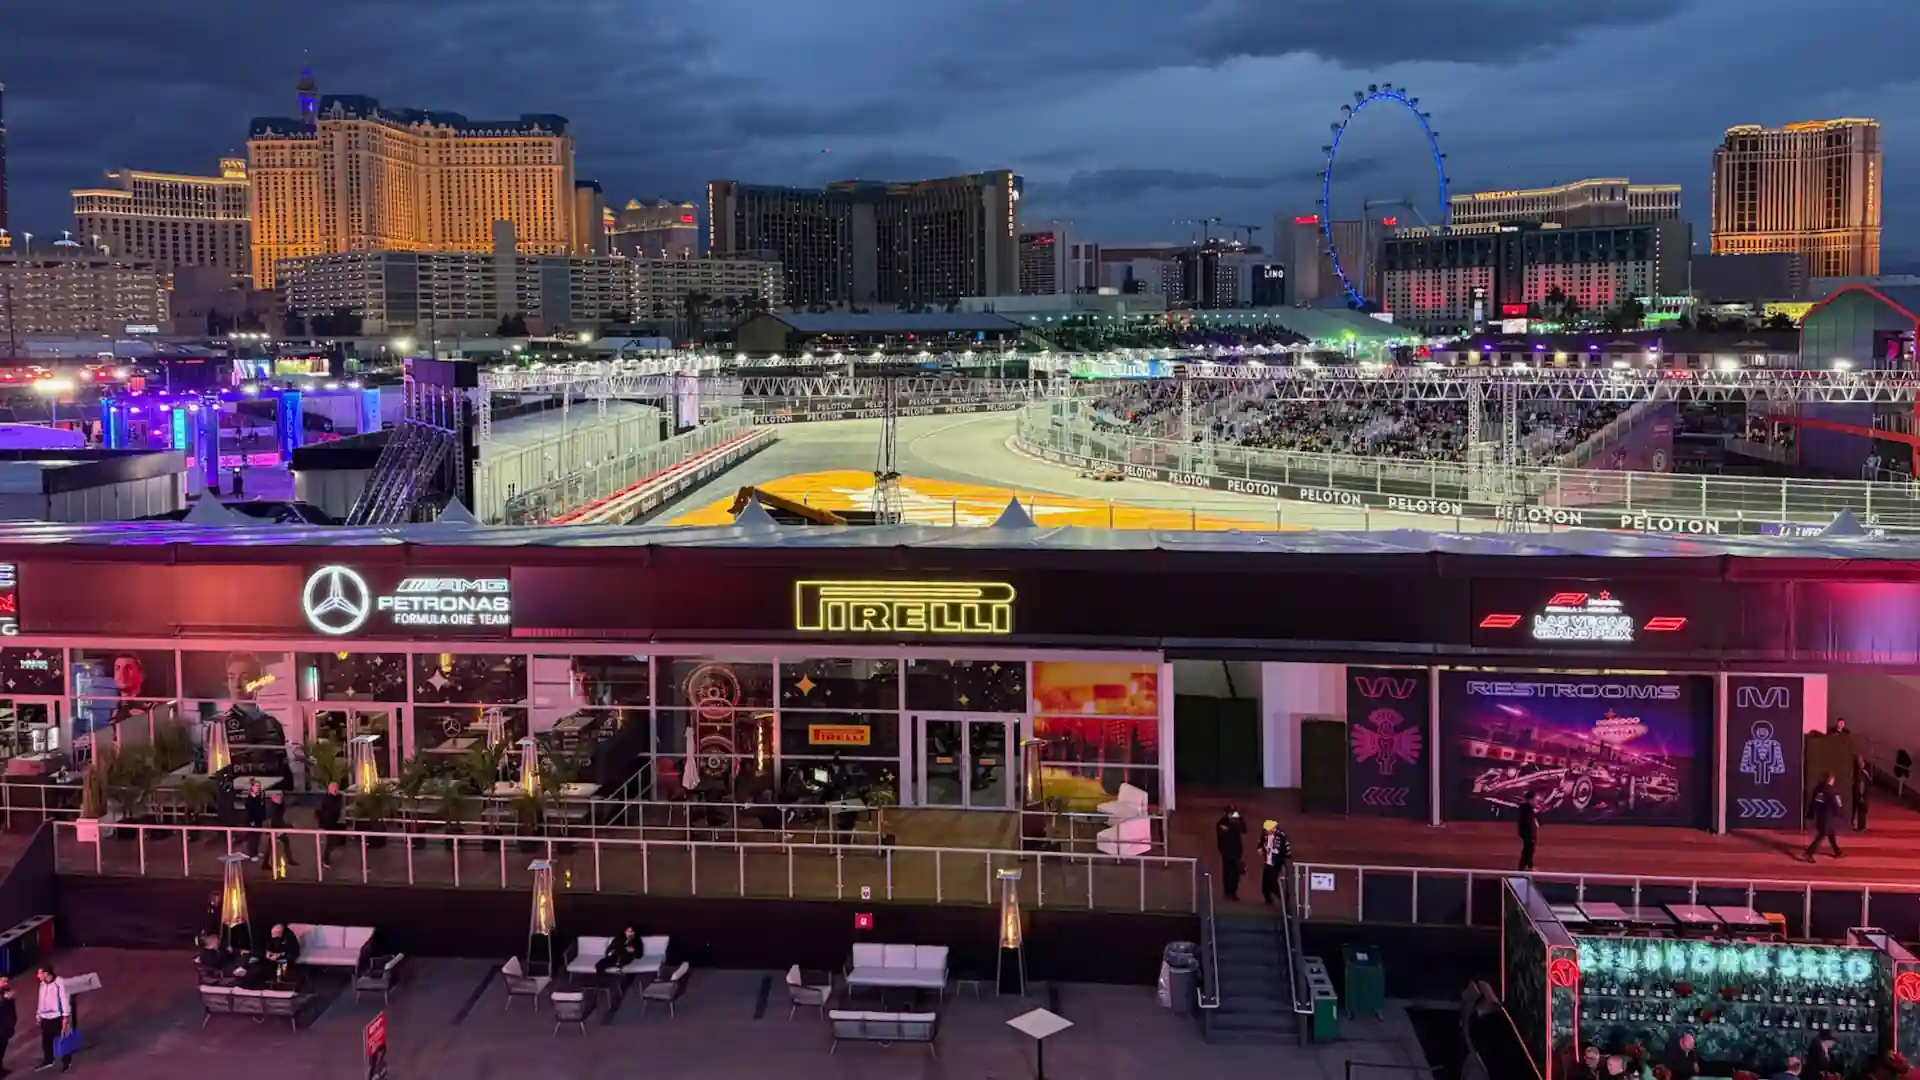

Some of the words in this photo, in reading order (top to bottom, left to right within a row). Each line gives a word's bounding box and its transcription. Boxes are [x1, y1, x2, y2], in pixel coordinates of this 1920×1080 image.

[1475, 190, 1519, 200] VENETIAN
[1264, 269, 1284, 279] LINQ
[816, 403, 852, 411] PELOTON
[754, 415, 793, 425] PELOTON
[1124, 464, 1159, 479] PELOTON
[1168, 471, 1211, 487] PELOTON
[1227, 479, 1279, 497] PELOTON
[1300, 488, 1361, 505] PELOTON
[1388, 496, 1462, 516] PELOTON
[1495, 505, 1582, 525] PELOTON
[1620, 514, 1719, 535] PELOTON
[377, 596, 510, 611] PETRONAS
[796, 580, 1016, 633] PIRELLI
[394, 613, 449, 625] FORMULA
[450, 613, 476, 625] ONE
[480, 613, 510, 625] TEAM
[1534, 614, 1569, 627] LAS
[1571, 615, 1634, 628] VEGAS
[1533, 626, 1591, 639] GRAND
[1593, 627, 1635, 641] PRIX
[1465, 680, 1681, 701] RESTROOMS
[813, 729, 865, 741] PIRELLI
